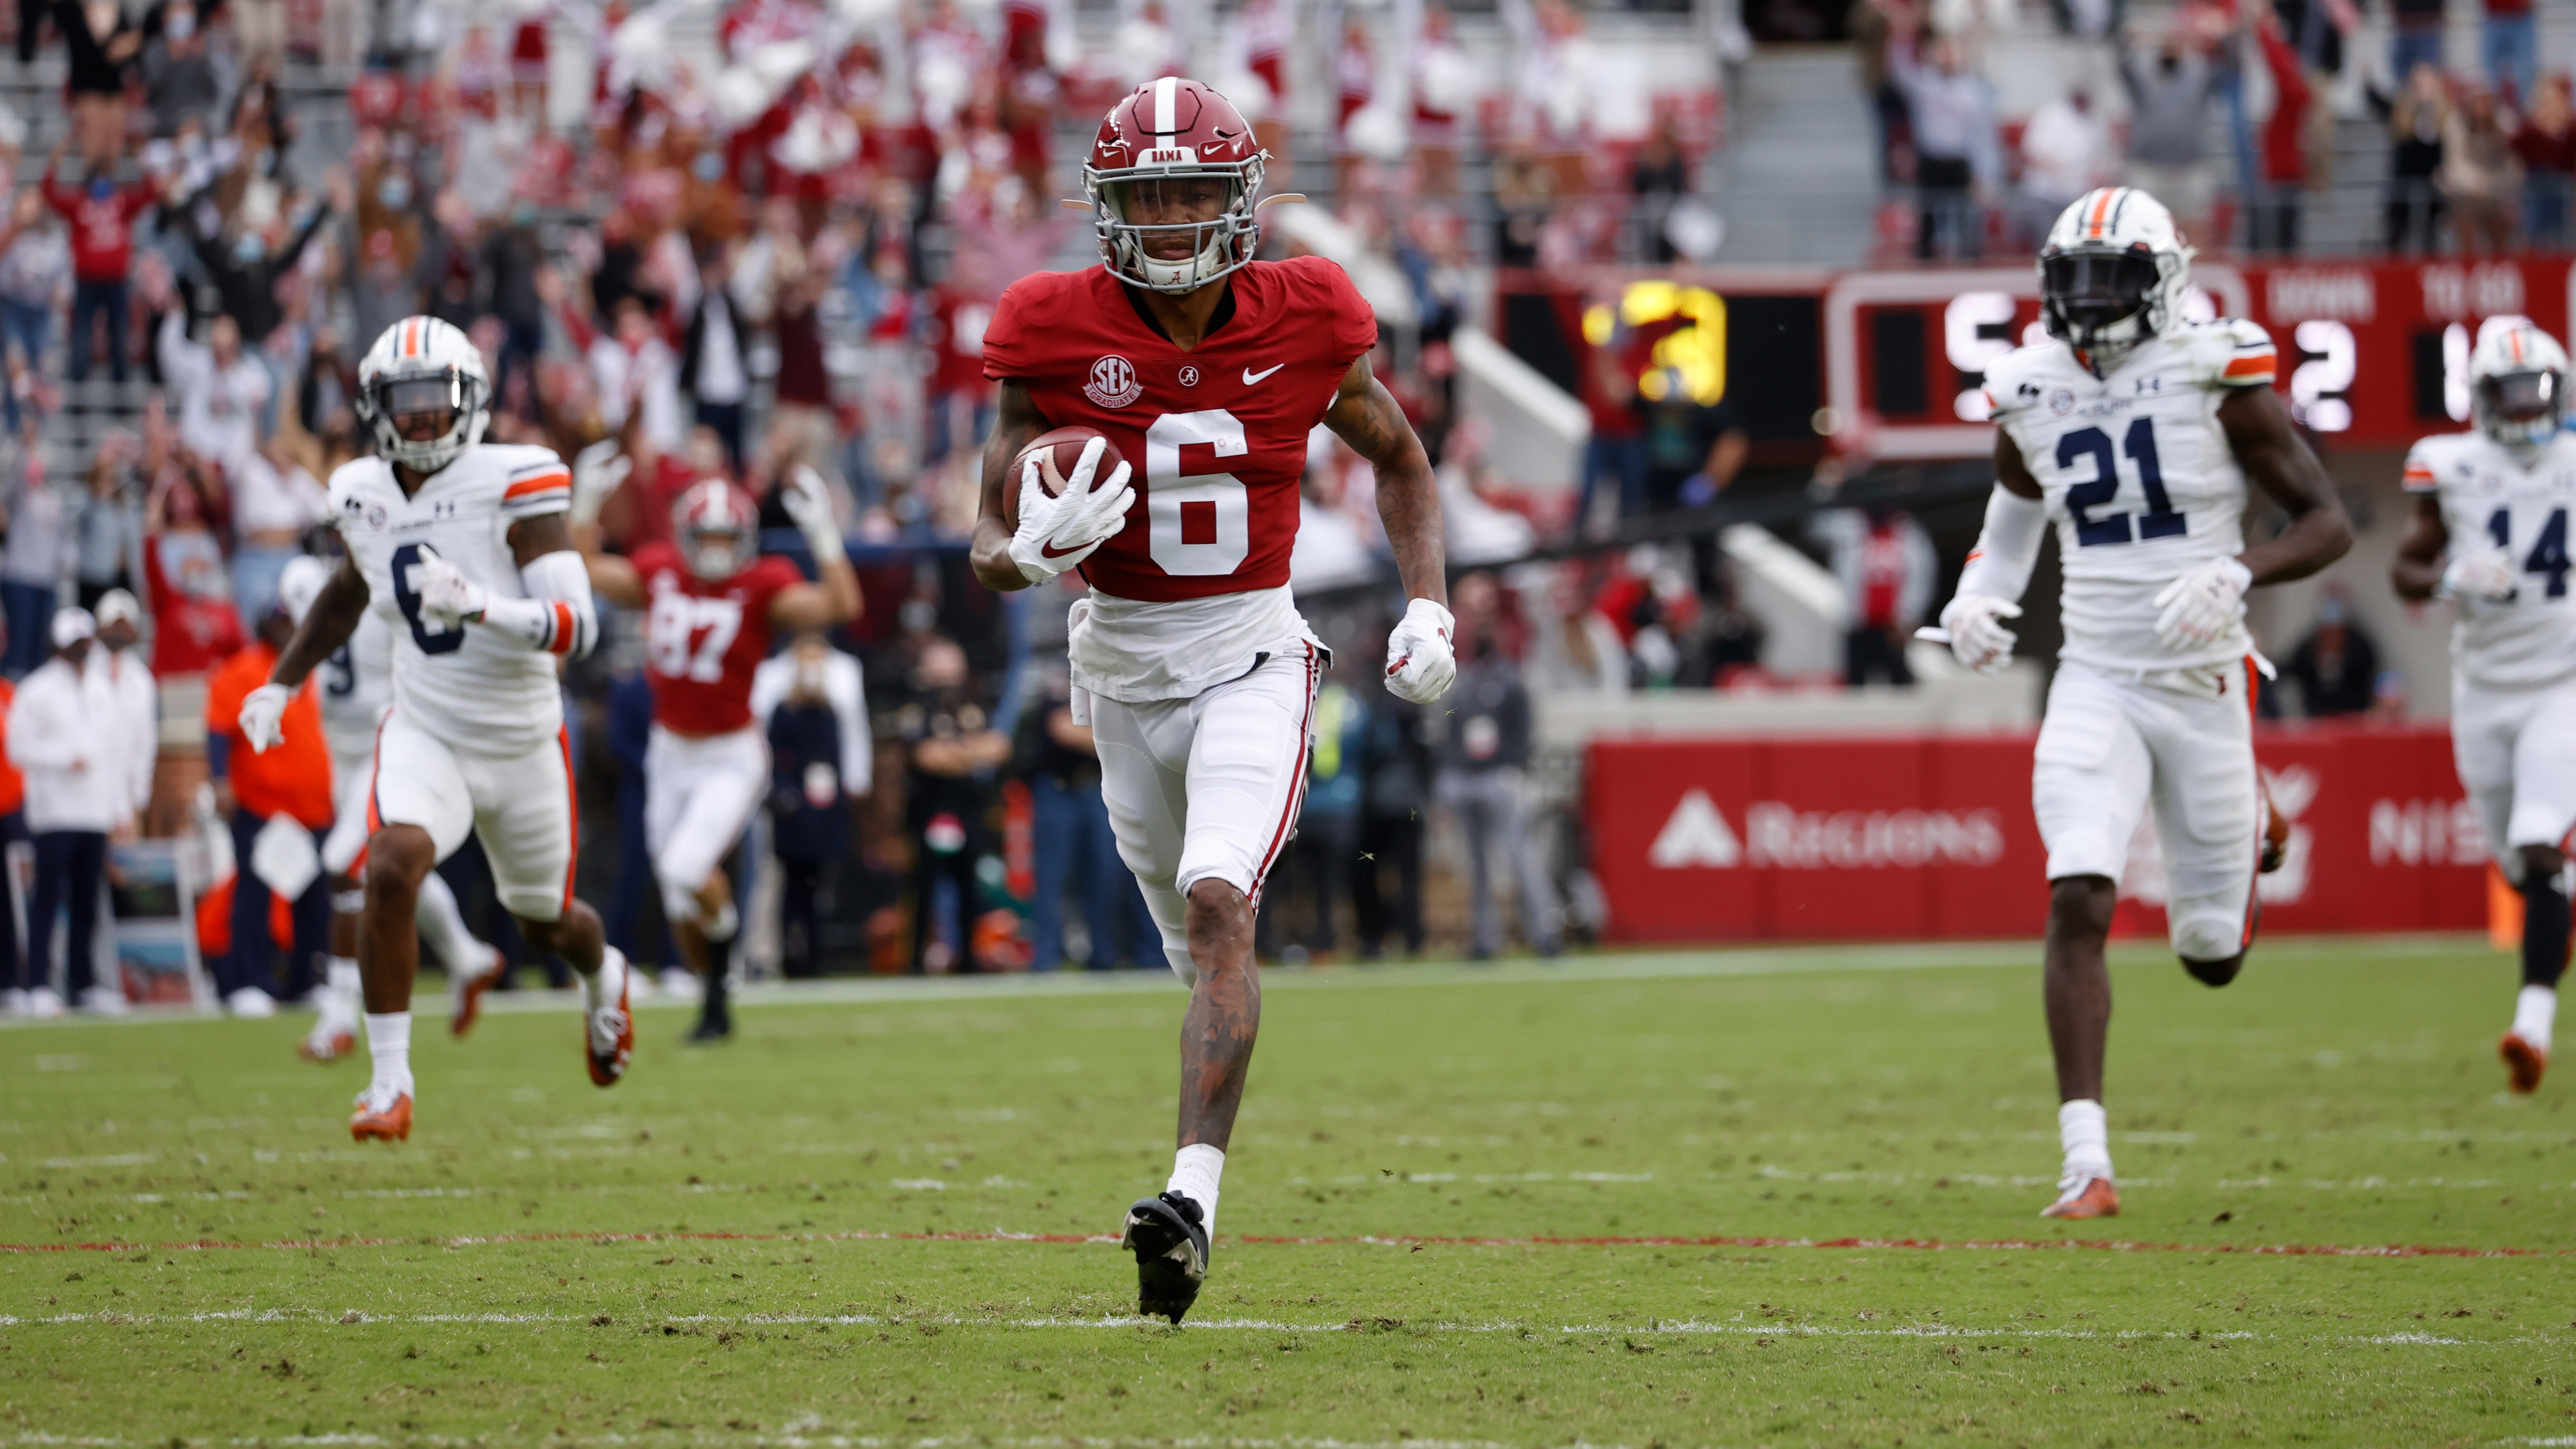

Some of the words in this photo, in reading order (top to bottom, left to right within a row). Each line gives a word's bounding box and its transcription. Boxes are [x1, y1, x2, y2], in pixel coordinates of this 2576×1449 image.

[1151, 150, 1182, 162] BAMA
[1089, 391, 1137, 407] GRADUATE
[1094, 358, 1131, 394] SEC
[2291, 320, 2356, 432] 2
[1145, 408, 1249, 576] 6
[2056, 416, 2187, 547] 21
[2484, 507, 2571, 600] 14
[648, 591, 743, 684] 87
